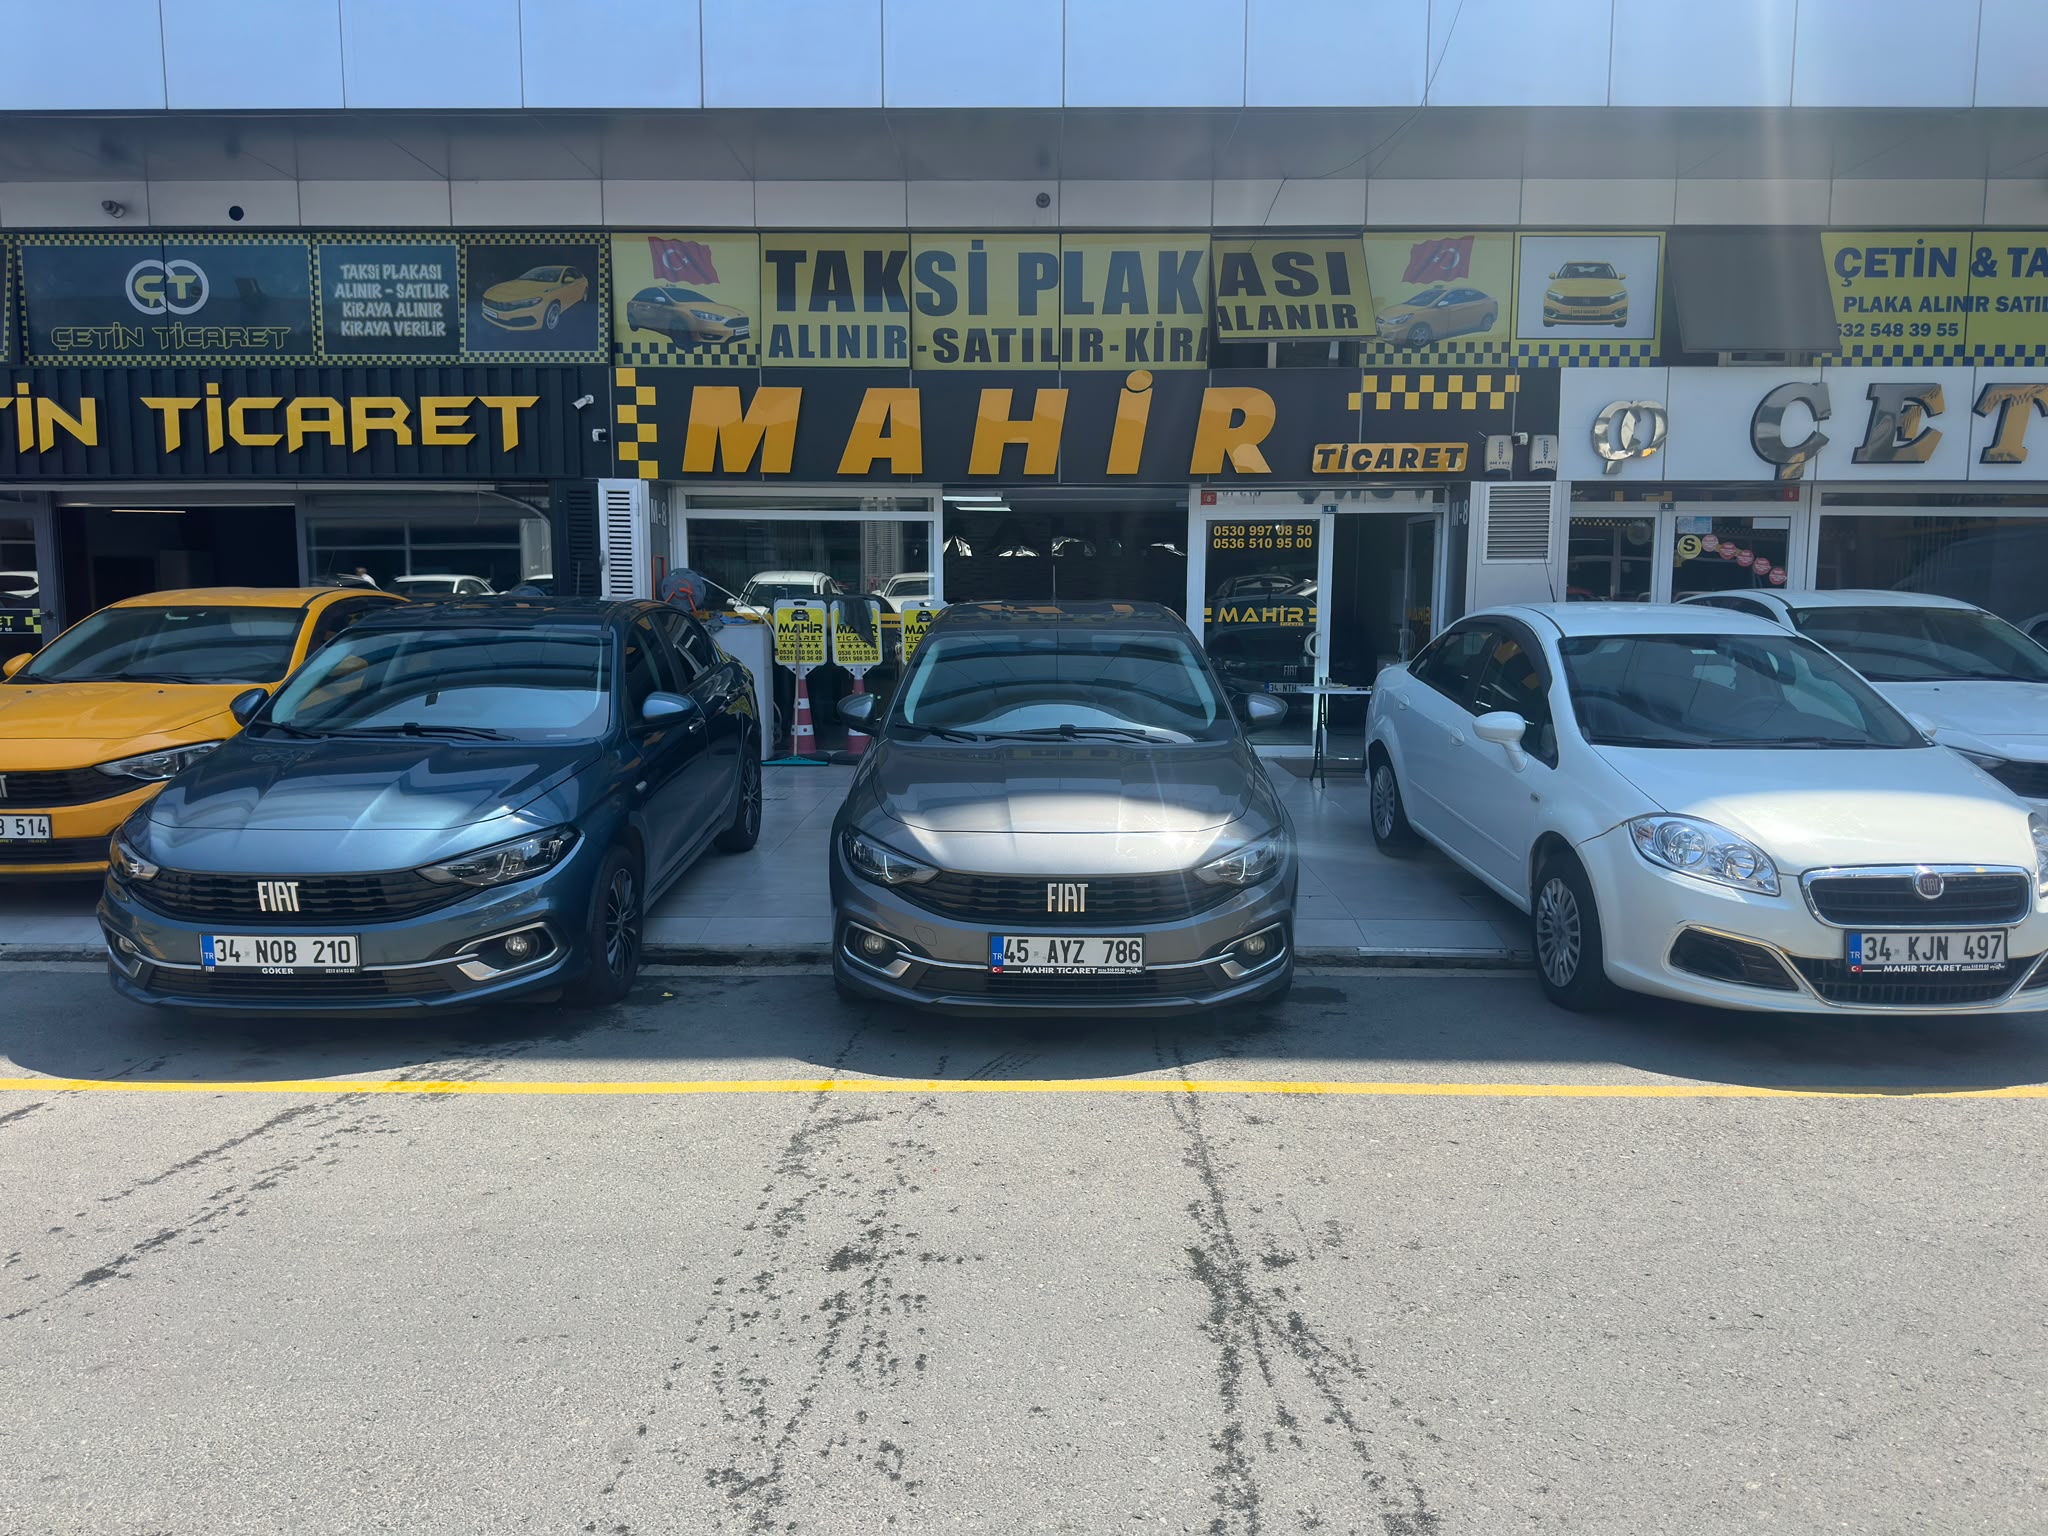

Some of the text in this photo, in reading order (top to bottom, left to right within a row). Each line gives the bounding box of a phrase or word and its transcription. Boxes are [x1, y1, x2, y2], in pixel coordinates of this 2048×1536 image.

[340, 263, 442, 280] TAKSİ PLAKASI
[1833, 239, 1957, 287] ÇETİN
[1971, 247, 1998, 278] &
[766, 239, 988, 317] TAKSİ
[334, 283, 383, 299] ALINIR
[396, 283, 450, 299] SATILIR
[342, 301, 443, 318] KİRAYA ALINIR
[1843, 296, 1912, 313] PLAKA
[1919, 296, 1990, 313] ALINIR
[51, 321, 291, 350] ÇETİN TİCARET
[341, 320, 447, 337] KİRAYA VERİLİR
[1870, 323, 1904, 337] 548
[1909, 323, 1931, 337] 39
[1936, 323, 1959, 337] 55
[0, 382, 540, 454] İN TİCARET
[682, 369, 1277, 476] MAHİR
[1316, 444, 1465, 470] TİCARET
[1213, 525, 1313, 536] 0530 997 08 50
[1213, 537, 1313, 549] 0536 510 95 00
[1683, 537, 1696, 552] S
[1218, 605, 1304, 623] MAHİR
[778, 621, 823, 633] MAHİR
[836, 624, 878, 634] MAR
[15, 819, 47, 836] 514
[1923, 880, 1939, 892] FIAT
[257, 881, 300, 912] FIAT
[1047, 883, 1089, 912] FIAT
[204, 952, 214, 960] TR
[214, 939, 350, 964] 34 NOB 210
[1004, 939, 1141, 964] 45 AYZ 786
[1864, 935, 2002, 961] 34 KJN 497
